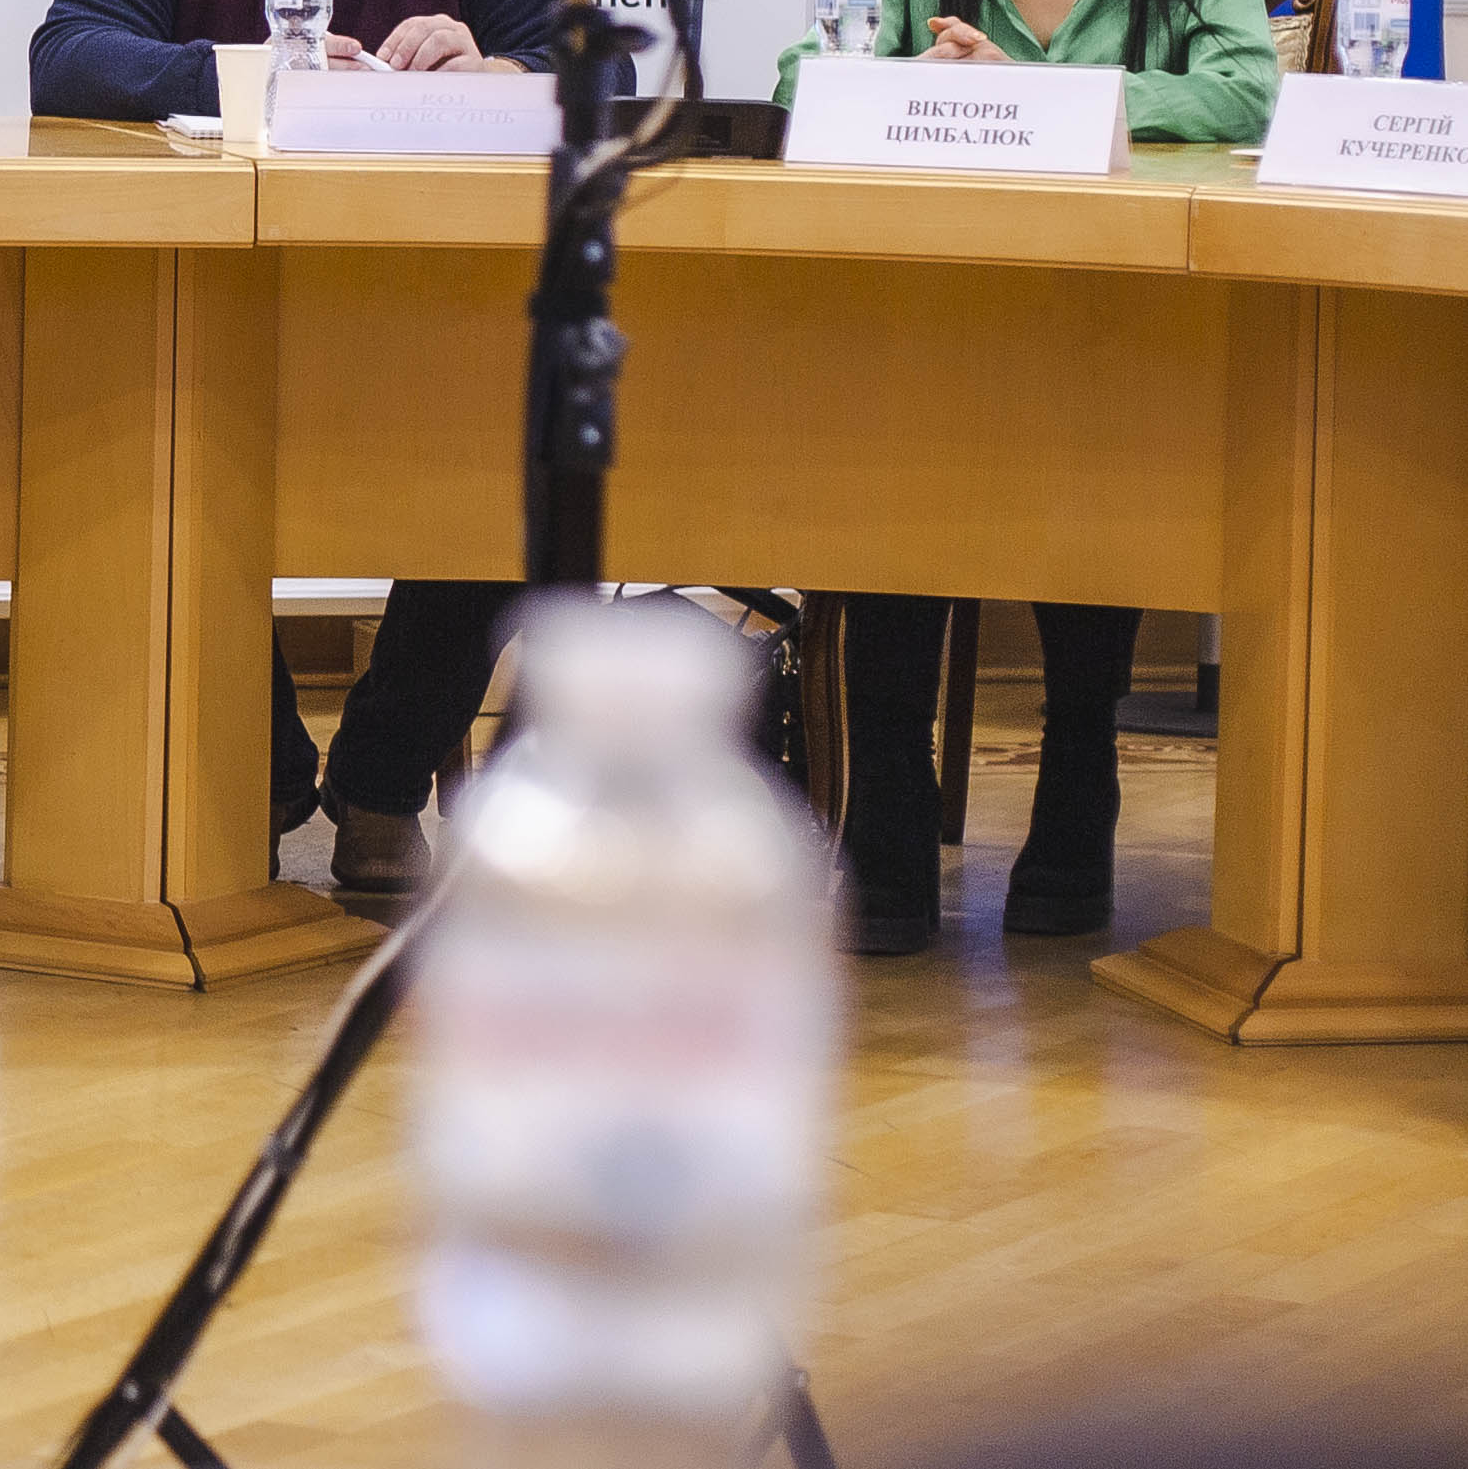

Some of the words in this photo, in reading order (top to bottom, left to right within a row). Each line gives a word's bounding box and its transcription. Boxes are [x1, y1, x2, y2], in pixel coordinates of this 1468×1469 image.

[907, 99, 1019, 120] ВІКТОРІЯ
[885, 125, 1034, 147] ЦИМБАЛЮК
[1373, 114, 1454, 136] СЕРГІЙ
[1339, 139, 1468, 164] КУЧЕРЕНКО
